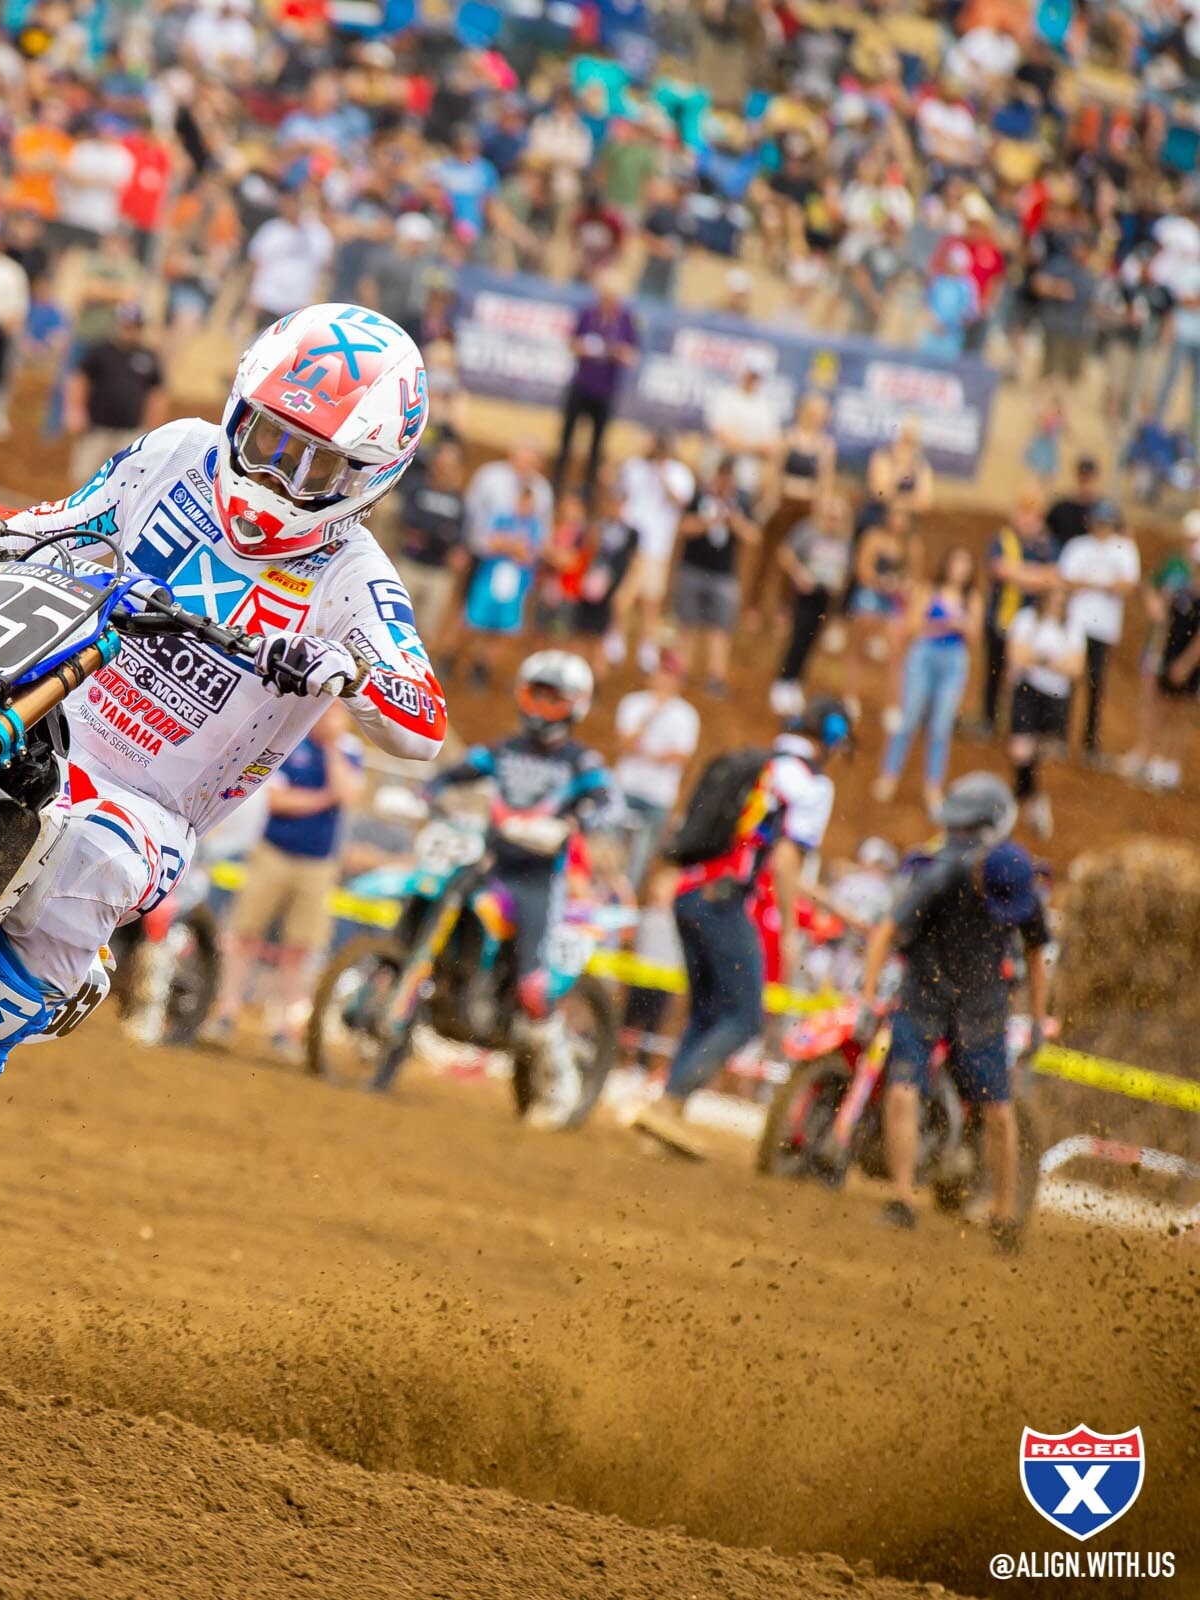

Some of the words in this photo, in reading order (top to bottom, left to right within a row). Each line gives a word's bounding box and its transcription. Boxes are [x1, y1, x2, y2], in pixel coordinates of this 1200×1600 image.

[181, 498, 220, 540] YAMAHA
[6, 563, 50, 579] LUCAS
[49, 569, 75, 590] OIL
[78, 703, 109, 742] FINANCIAL
[109, 736, 151, 770] SERVICES
[99, 695, 165, 756] YAMAHA
